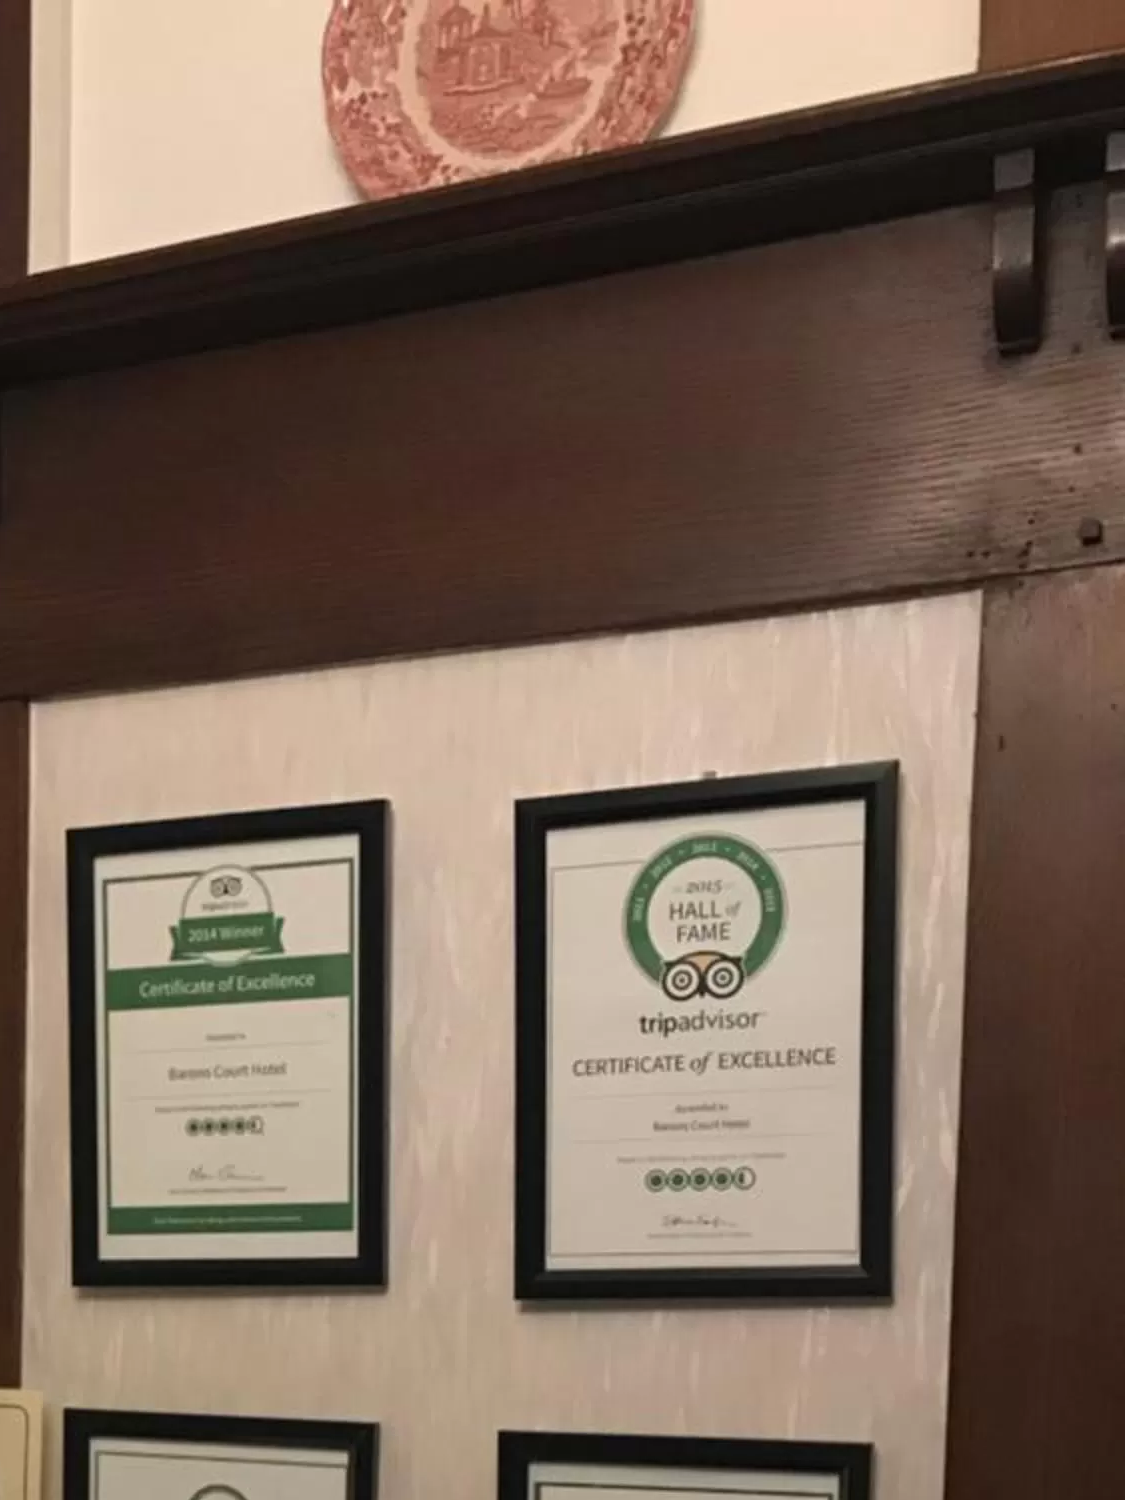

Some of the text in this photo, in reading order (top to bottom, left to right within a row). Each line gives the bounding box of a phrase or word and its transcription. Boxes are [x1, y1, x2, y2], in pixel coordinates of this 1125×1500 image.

[669, 899, 742, 922] HALL of
[188, 925, 264, 943] 2014 Winner
[676, 921, 732, 944] FAME
[138, 972, 316, 999] Certificate of Excellence
[639, 1009, 761, 1038] tripadvisor
[168, 1066, 211, 1081] Barons
[213, 1063, 249, 1079] Court
[572, 1046, 837, 1078] CERTIFICATE of EXCELLENCE
